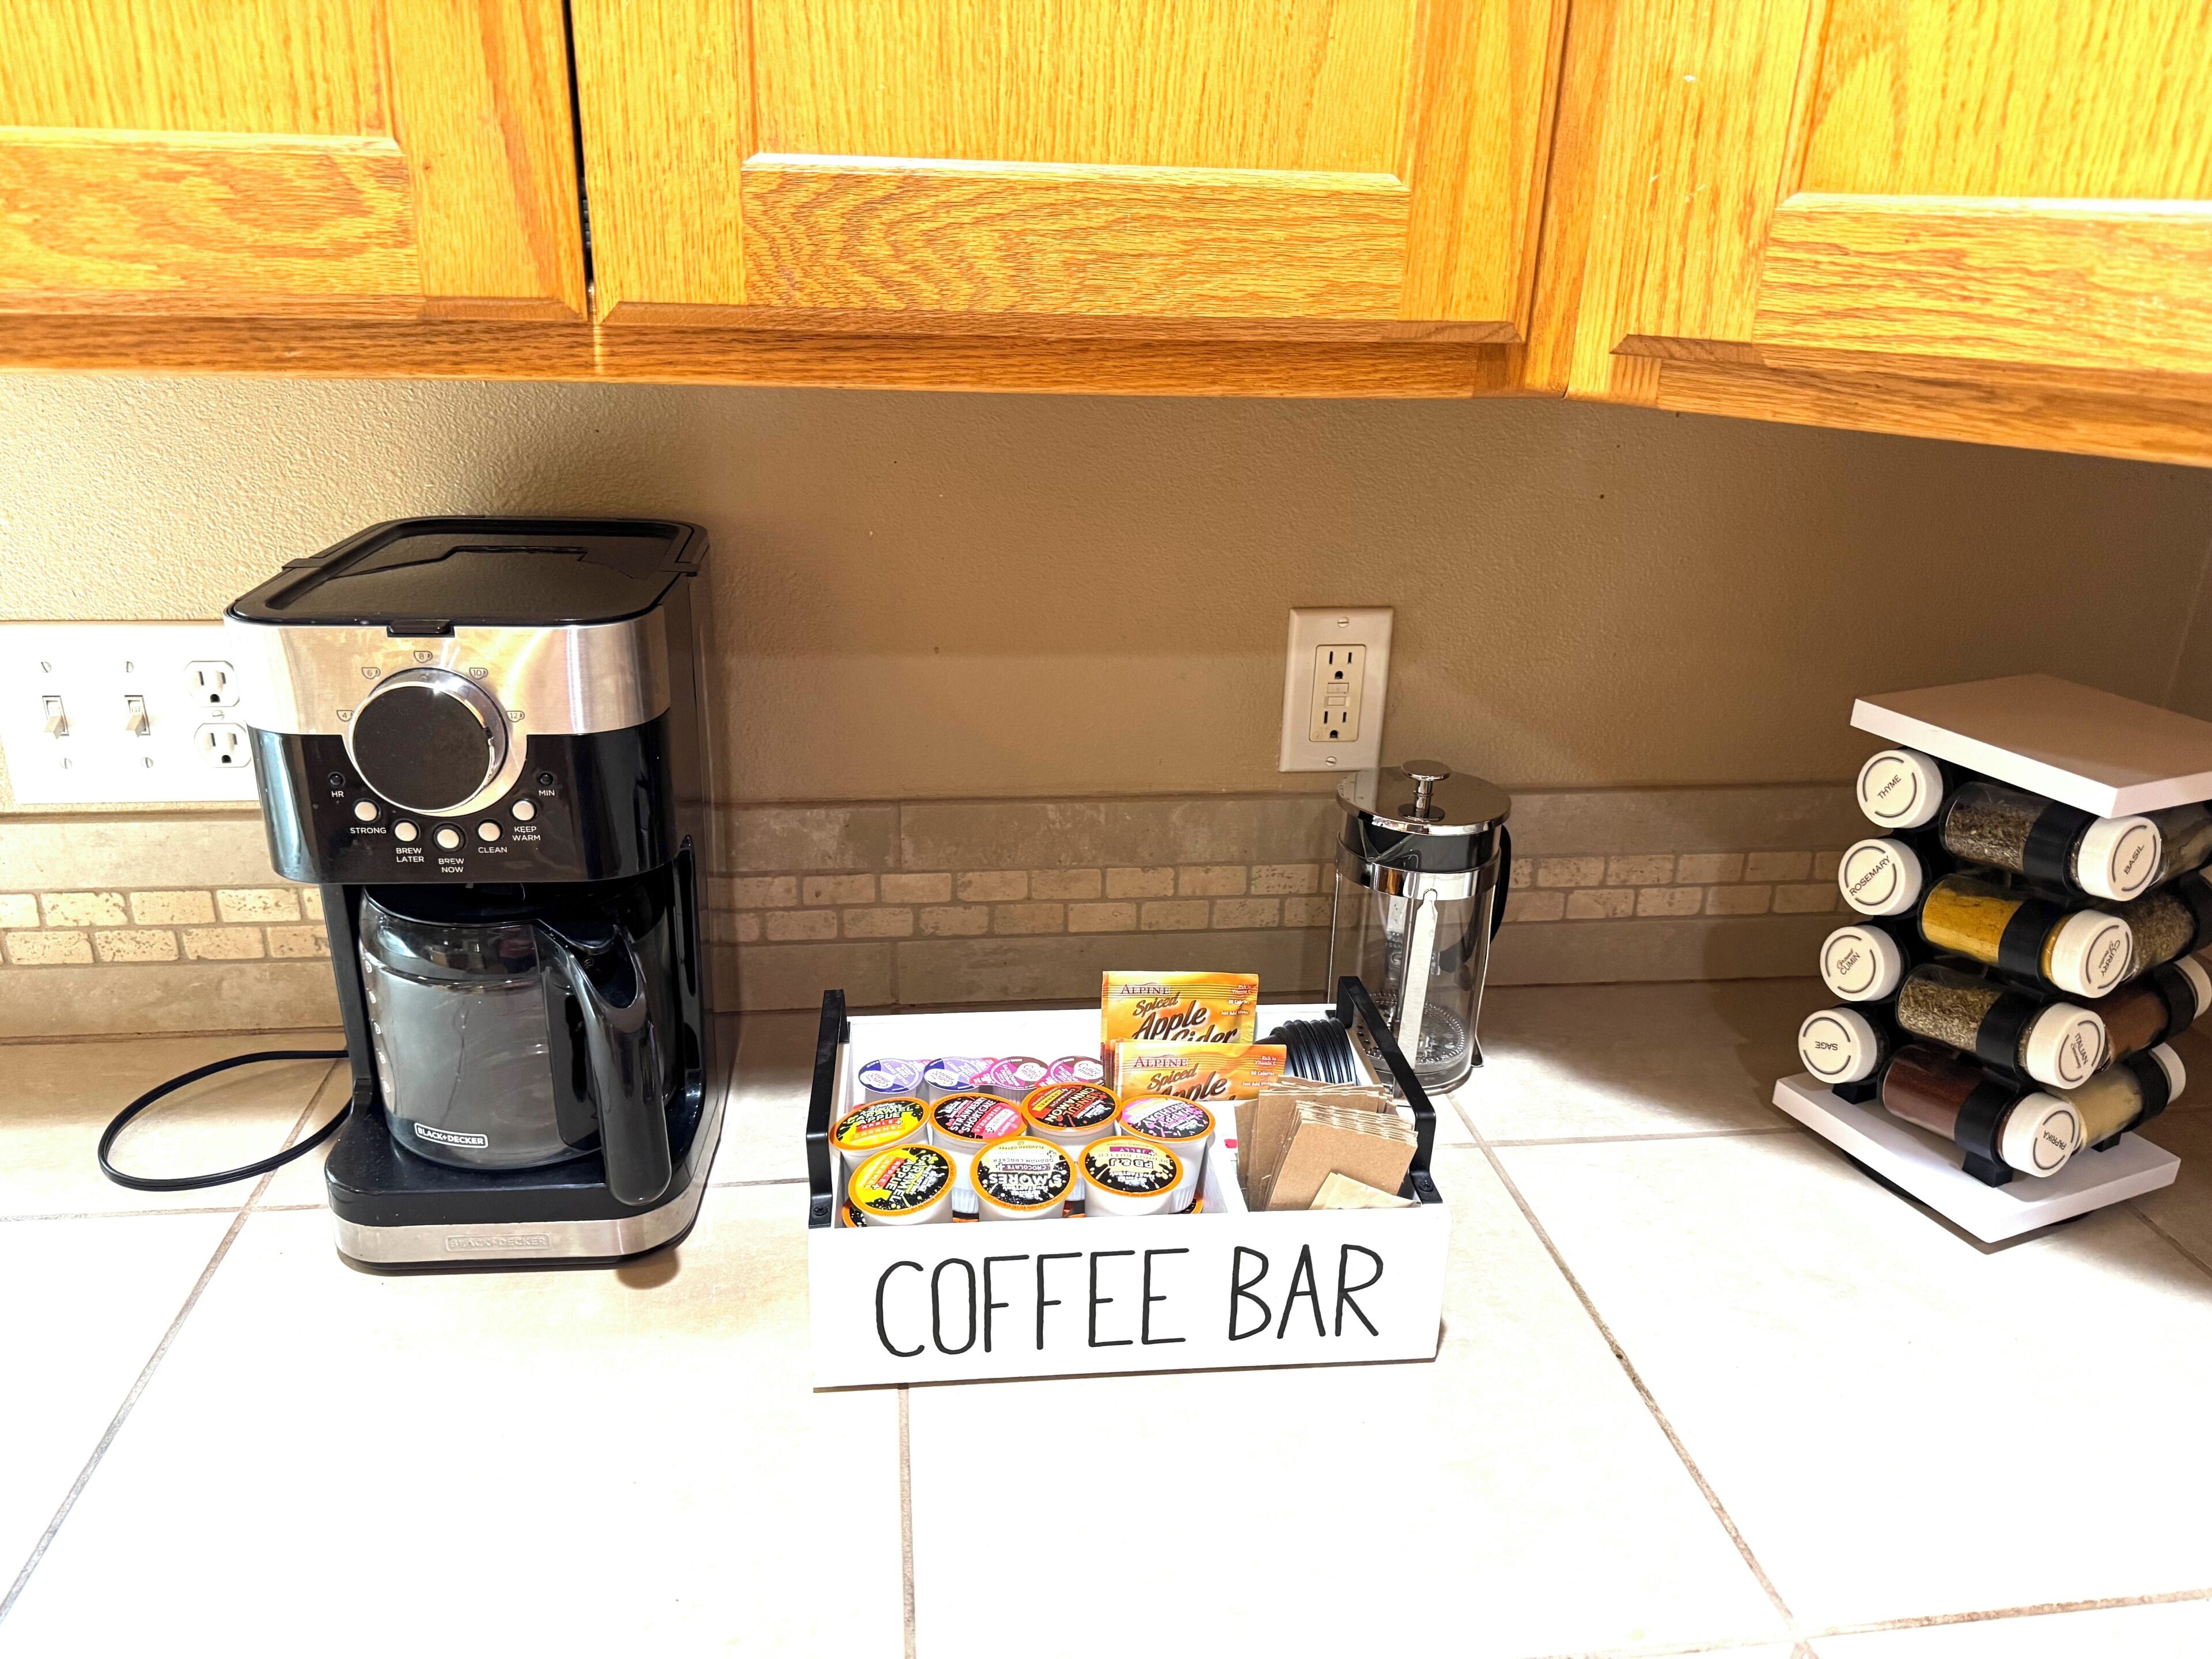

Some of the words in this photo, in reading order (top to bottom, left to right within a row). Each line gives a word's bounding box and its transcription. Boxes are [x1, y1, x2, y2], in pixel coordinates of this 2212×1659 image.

[1876, 774, 1902, 800] THYME
[2123, 843, 2145, 875] BASIL
[1849, 855, 1891, 897] ROSEMARY
[1839, 952, 1861, 975] CUMIN
[2100, 939, 2121, 978] CURRY
[1120, 983, 1171, 995] ALPINE
[1132, 991, 1180, 1018] Spiced
[1131, 999, 1208, 1041] Apple
[1814, 1040, 1839, 1051] SAGE
[2074, 1032, 2089, 1066] ITALIAN
[1133, 1055, 1188, 1068] ALPINE
[1146, 1062, 1200, 1091] Spiced
[847, 1105, 914, 1123] CARAMEL
[950, 1096, 988, 1132] STRAWBERRY
[961, 1099, 997, 1133] SHORTCAKE
[1044, 1088, 1096, 1123] CINNAMON
[1063, 1091, 1097, 1116] SINFUL
[1142, 1103, 1190, 1127] BIRTHDAY
[857, 1112, 902, 1126] APPLE
[1158, 1106, 1192, 1127] HAPPY
[417, 1127, 484, 1145] BLACK+DECKER
[2043, 1130, 2067, 1151] PAPRIKA
[885, 1158, 913, 1192] APPLE
[1108, 1158, 1118, 1167] J
[1119, 1158, 1132, 1167] &
[1133, 1158, 1154, 1169] PB
[889, 1154, 931, 1202] CARAMEL
[450, 1237, 547, 1247] BLACK+DECKER
[874, 1247, 1190, 1358] COFFEE
[1228, 1243, 1385, 1341] BAR
